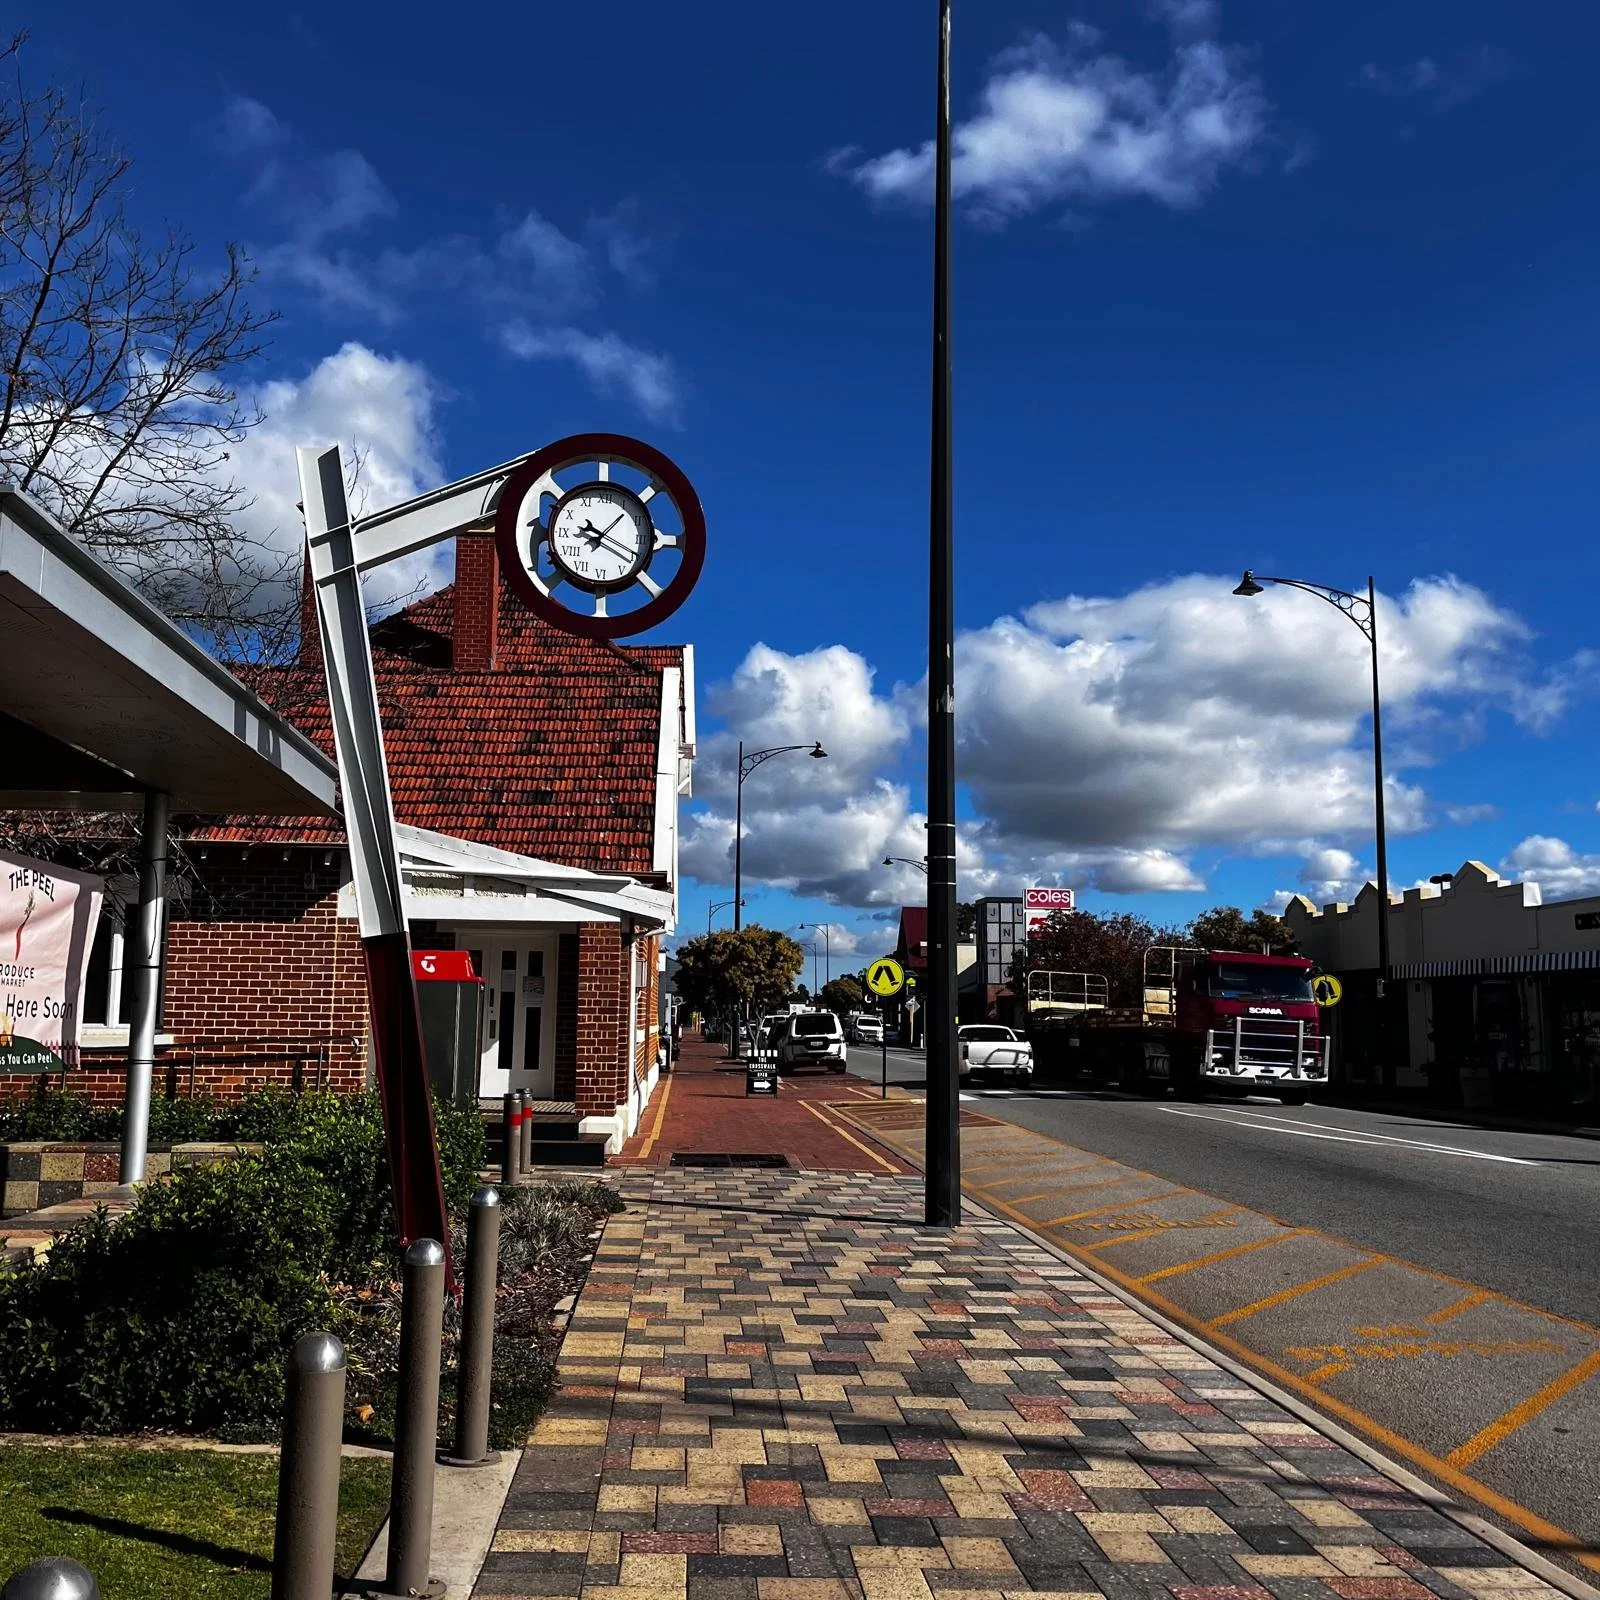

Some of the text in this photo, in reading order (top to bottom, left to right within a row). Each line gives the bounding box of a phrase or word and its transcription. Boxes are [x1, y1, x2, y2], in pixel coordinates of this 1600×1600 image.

[580, 497, 592, 507] XI
[597, 493, 613, 504] XII
[566, 510, 574, 520] X
[634, 515, 641, 526] II
[558, 528, 569, 538] IX
[635, 535, 646, 544] III
[561, 546, 580, 556] VIII
[574, 561, 588, 572] VII
[618, 565, 626, 575] V
[595, 569, 606, 579] VI
[9, 868, 54, 902] THE PEEL
[1028, 890, 1070, 903] coles
[1, 978, 25, 987] MARKET
[6, 994, 73, 1019] Here Soon
[1249, 1007, 1282, 1015] SCANIA
[7, 1053, 20, 1065] You
[22, 1053, 36, 1064] Can
[37, 1052, 52, 1064] Peel
